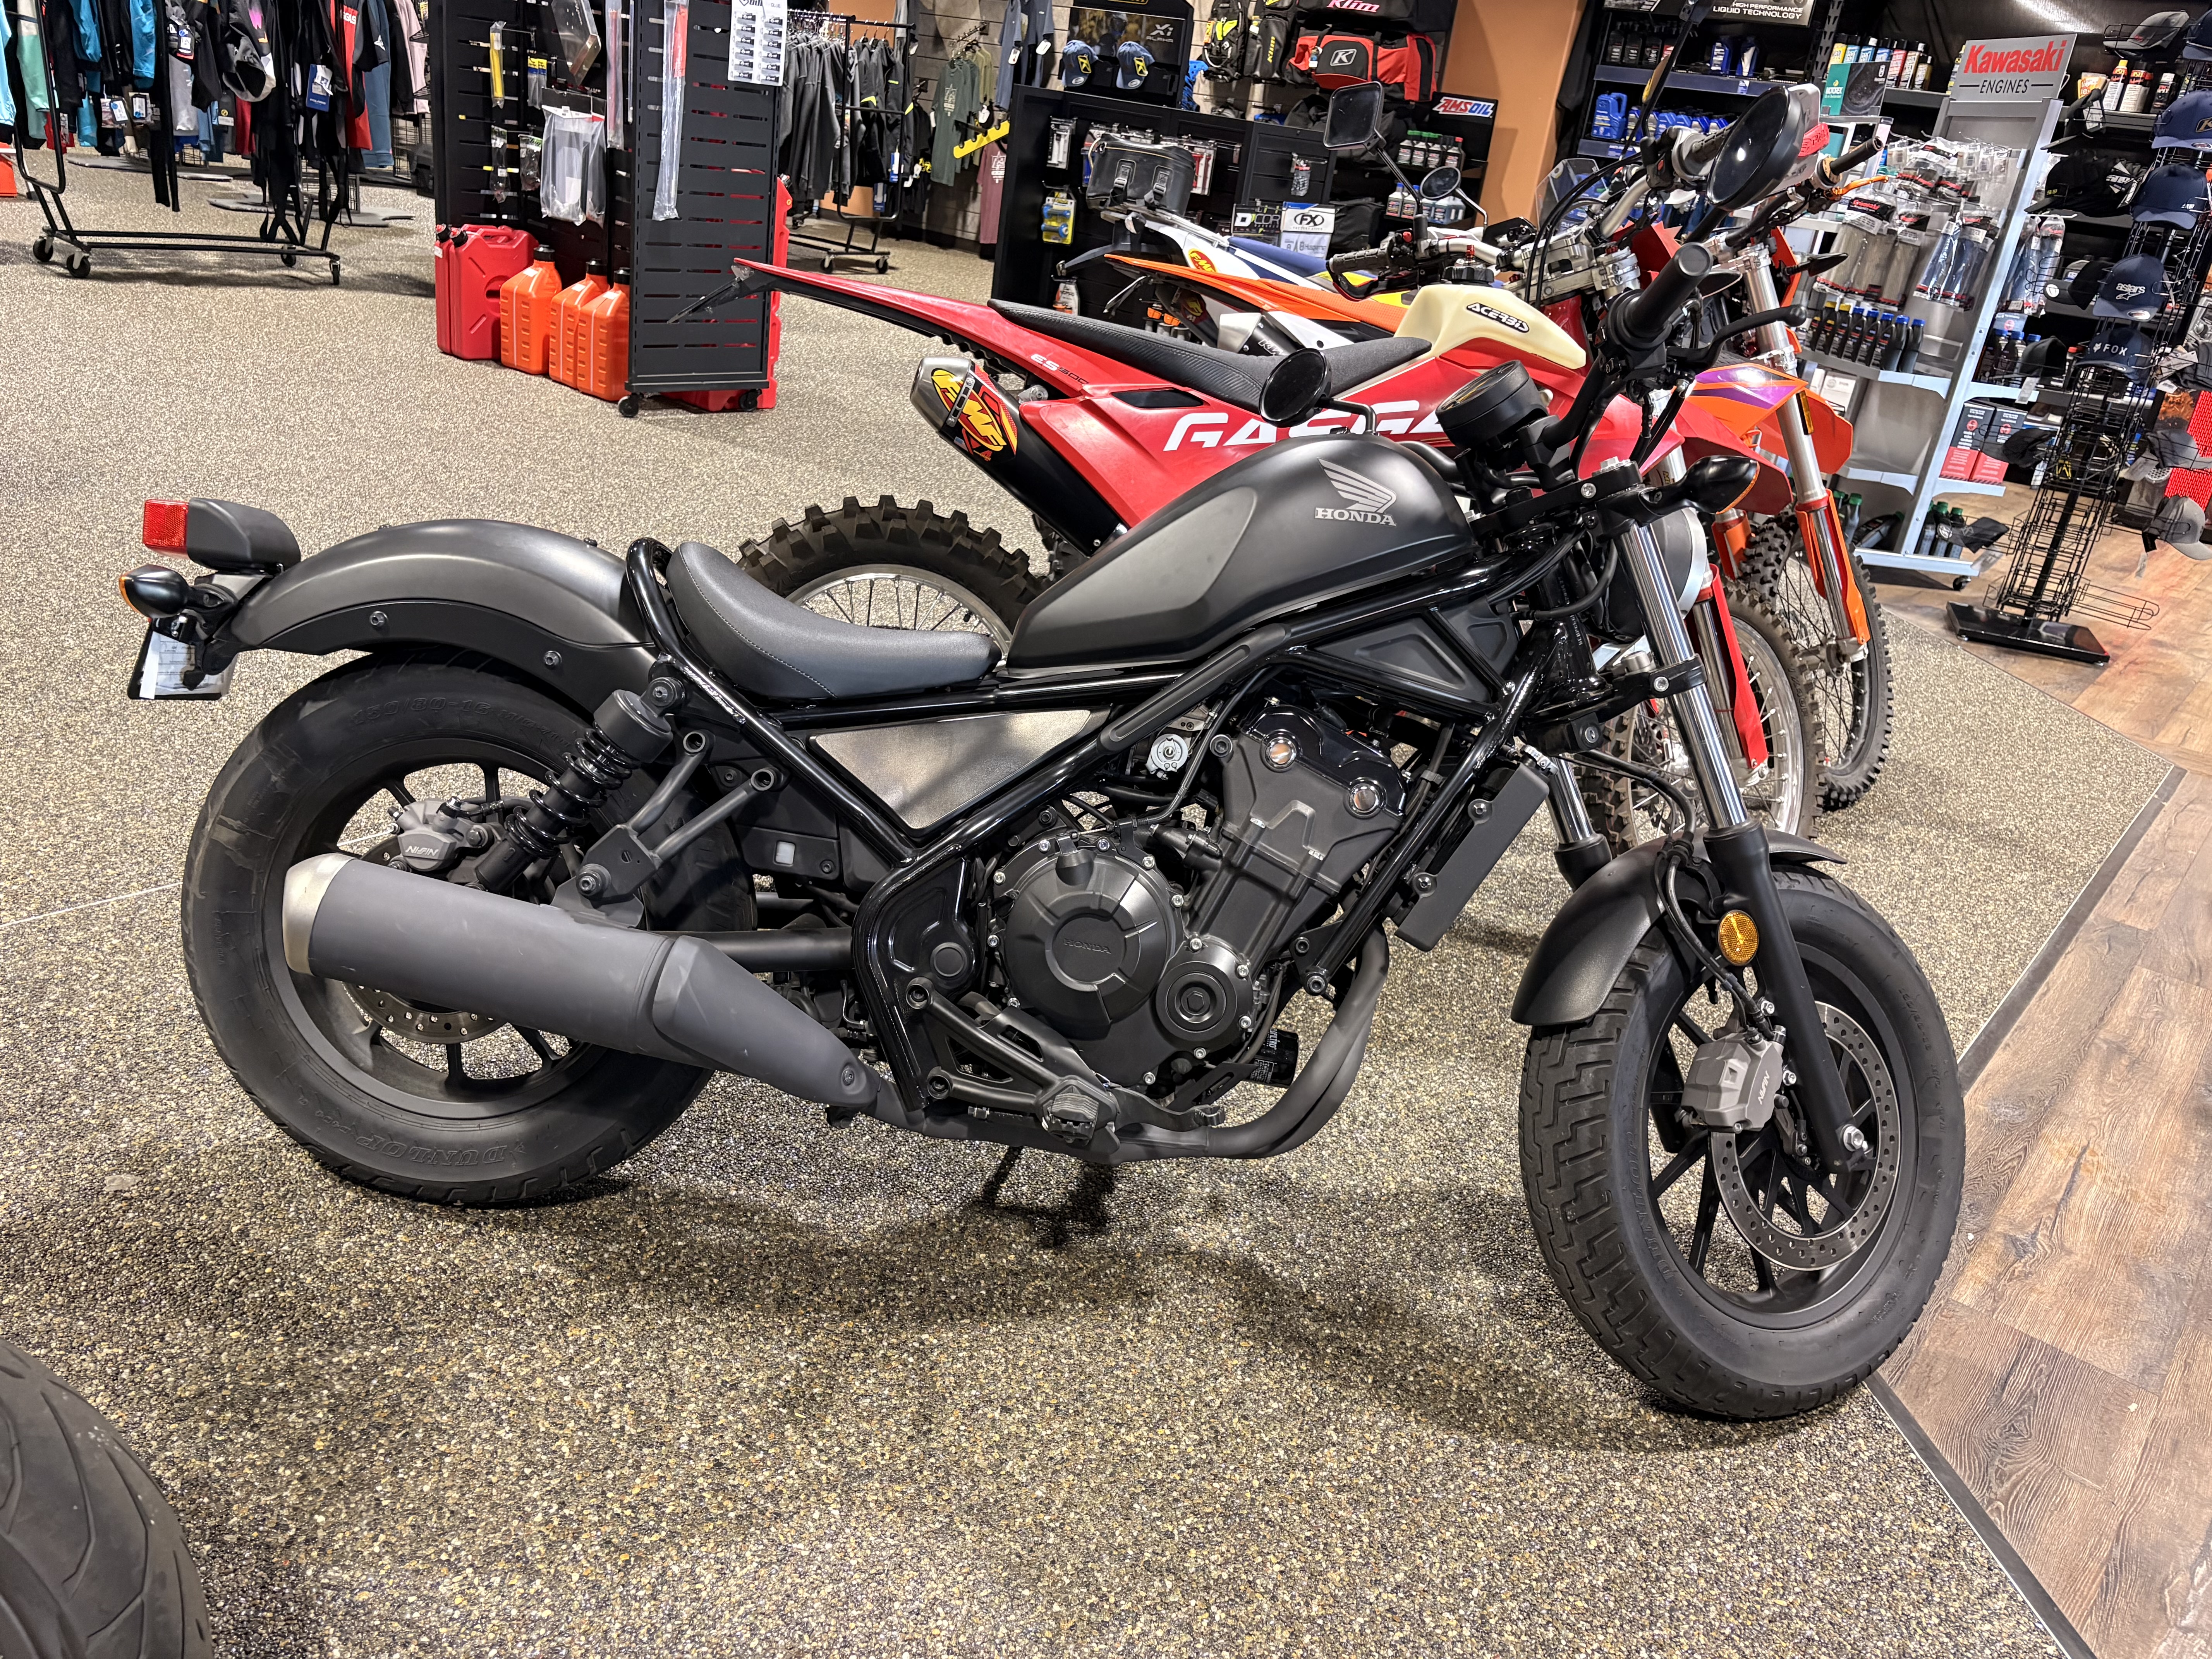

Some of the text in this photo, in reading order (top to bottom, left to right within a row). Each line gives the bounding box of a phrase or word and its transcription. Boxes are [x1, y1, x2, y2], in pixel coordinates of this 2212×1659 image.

[1327, 0, 1380, 13] Klim
[1713, 6, 1802, 19] LIQUID TECHNOLOGY
[1750, 3, 1803, 13] PERFORMANCE
[1963, 40, 2068, 74] Kawasaki
[1980, 79, 2029, 94] ENGINES
[1435, 98, 1493, 116] AMSOIL
[1299, 214, 1320, 227] FX
[2116, 283, 2146, 294] astars
[2103, 343, 2128, 356] FOX
[1315, 507, 1397, 526] HONDA
[1063, 938, 1111, 955] HONDA
[356, 1134, 508, 1166] DUNLOP
